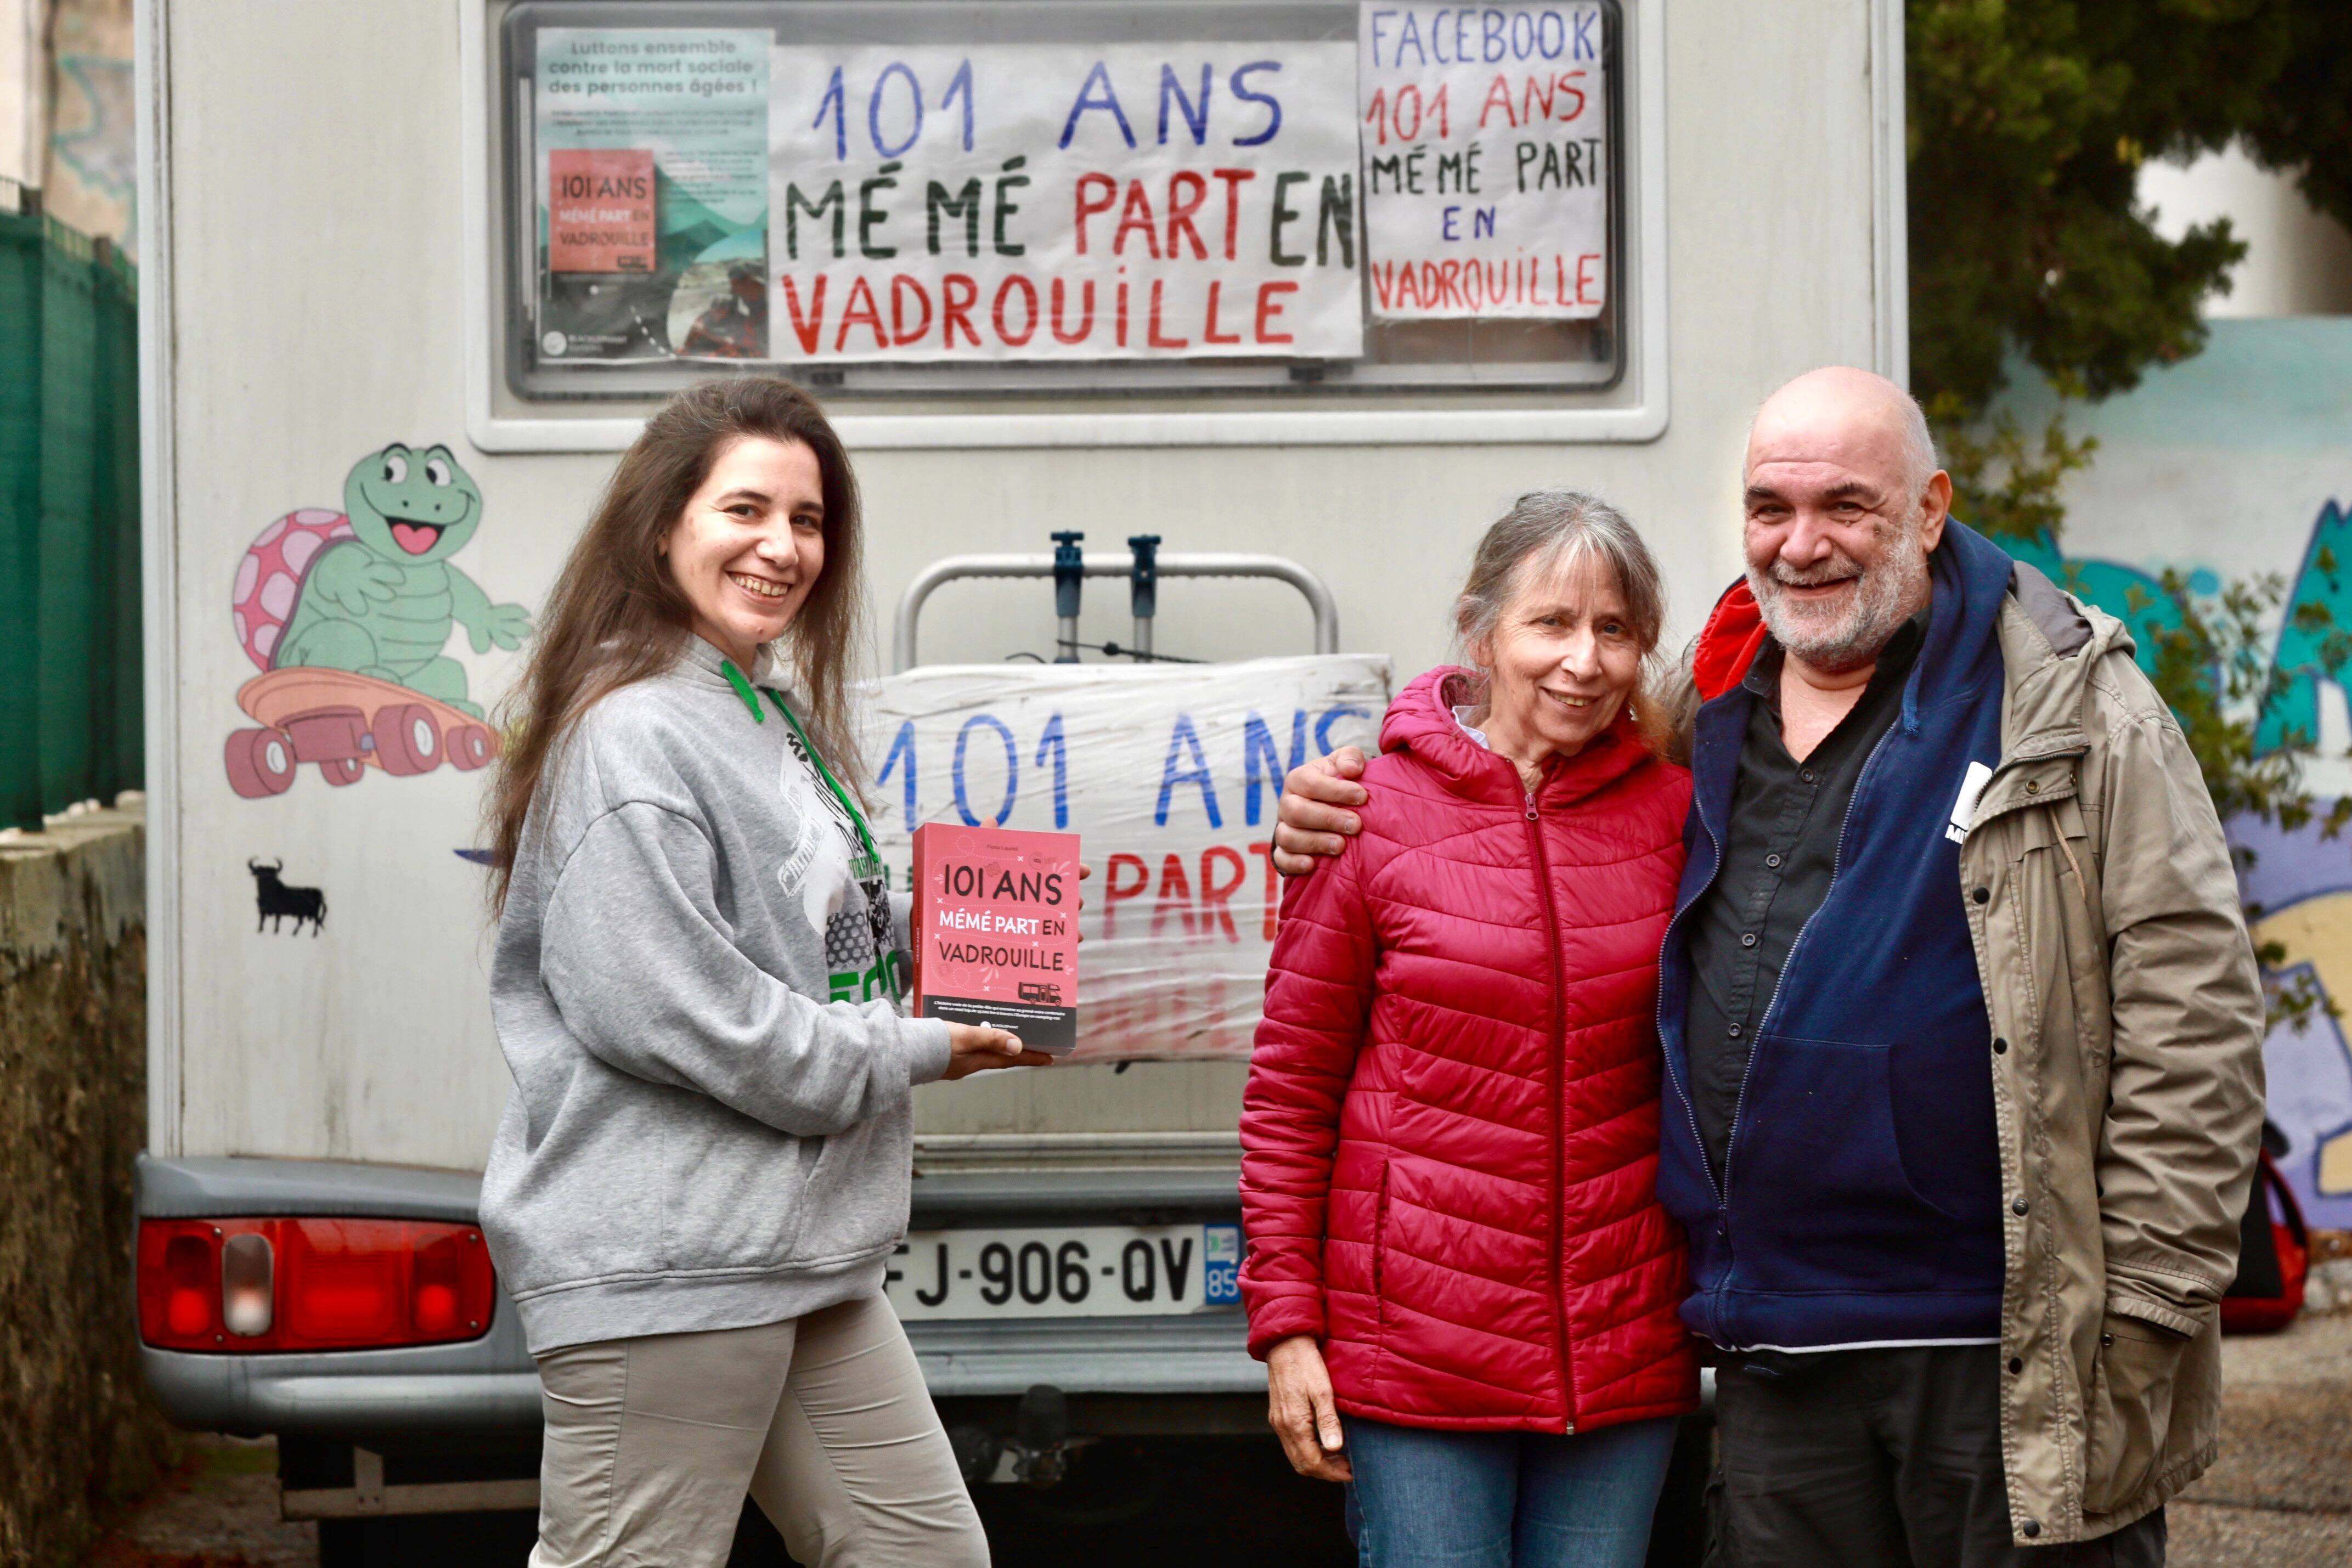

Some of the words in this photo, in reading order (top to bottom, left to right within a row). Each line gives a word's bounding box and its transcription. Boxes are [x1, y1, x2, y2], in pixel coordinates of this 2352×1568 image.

[571, 41, 639, 55] Luttons
[645, 40, 736, 55] ensemble
[1373, 9, 1597, 68] FACEBOOK
[549, 60, 608, 75] contre
[614, 60, 631, 74] la
[638, 59, 681, 74] mort
[687, 58, 753, 74] sociale
[549, 78, 581, 93] des
[588, 81, 684, 97] personnes
[690, 78, 745, 97] âgées
[813, 58, 974, 162] 101
[1058, 60, 1285, 151] ANS
[1366, 83, 1448, 146] 101
[1478, 70, 1587, 129] ANS
[1515, 138, 1601, 194] PART
[562, 174, 591, 200] 101
[597, 176, 647, 200] ANS
[559, 206, 596, 223] MÉMÉ
[599, 209, 631, 223] PART
[1075, 168, 1255, 261] PART
[1270, 171, 1355, 269] EN
[1442, 205, 1496, 242] EN
[560, 231, 649, 247] VADROUILLE
[877, 711, 1069, 833] 101
[944, 864, 984, 899] 101
[993, 870, 1063, 906] ANS
[1103, 842, 1279, 944] PART
[939, 908, 991, 932] MÉMÉ
[995, 917, 1039, 935] PART
[1042, 920, 1065, 936] EN
[939, 941, 1064, 972] VADROUILLE
[882, 1238, 1193, 1307] FJ-906-QV
[1208, 1268, 1238, 1297] 85
